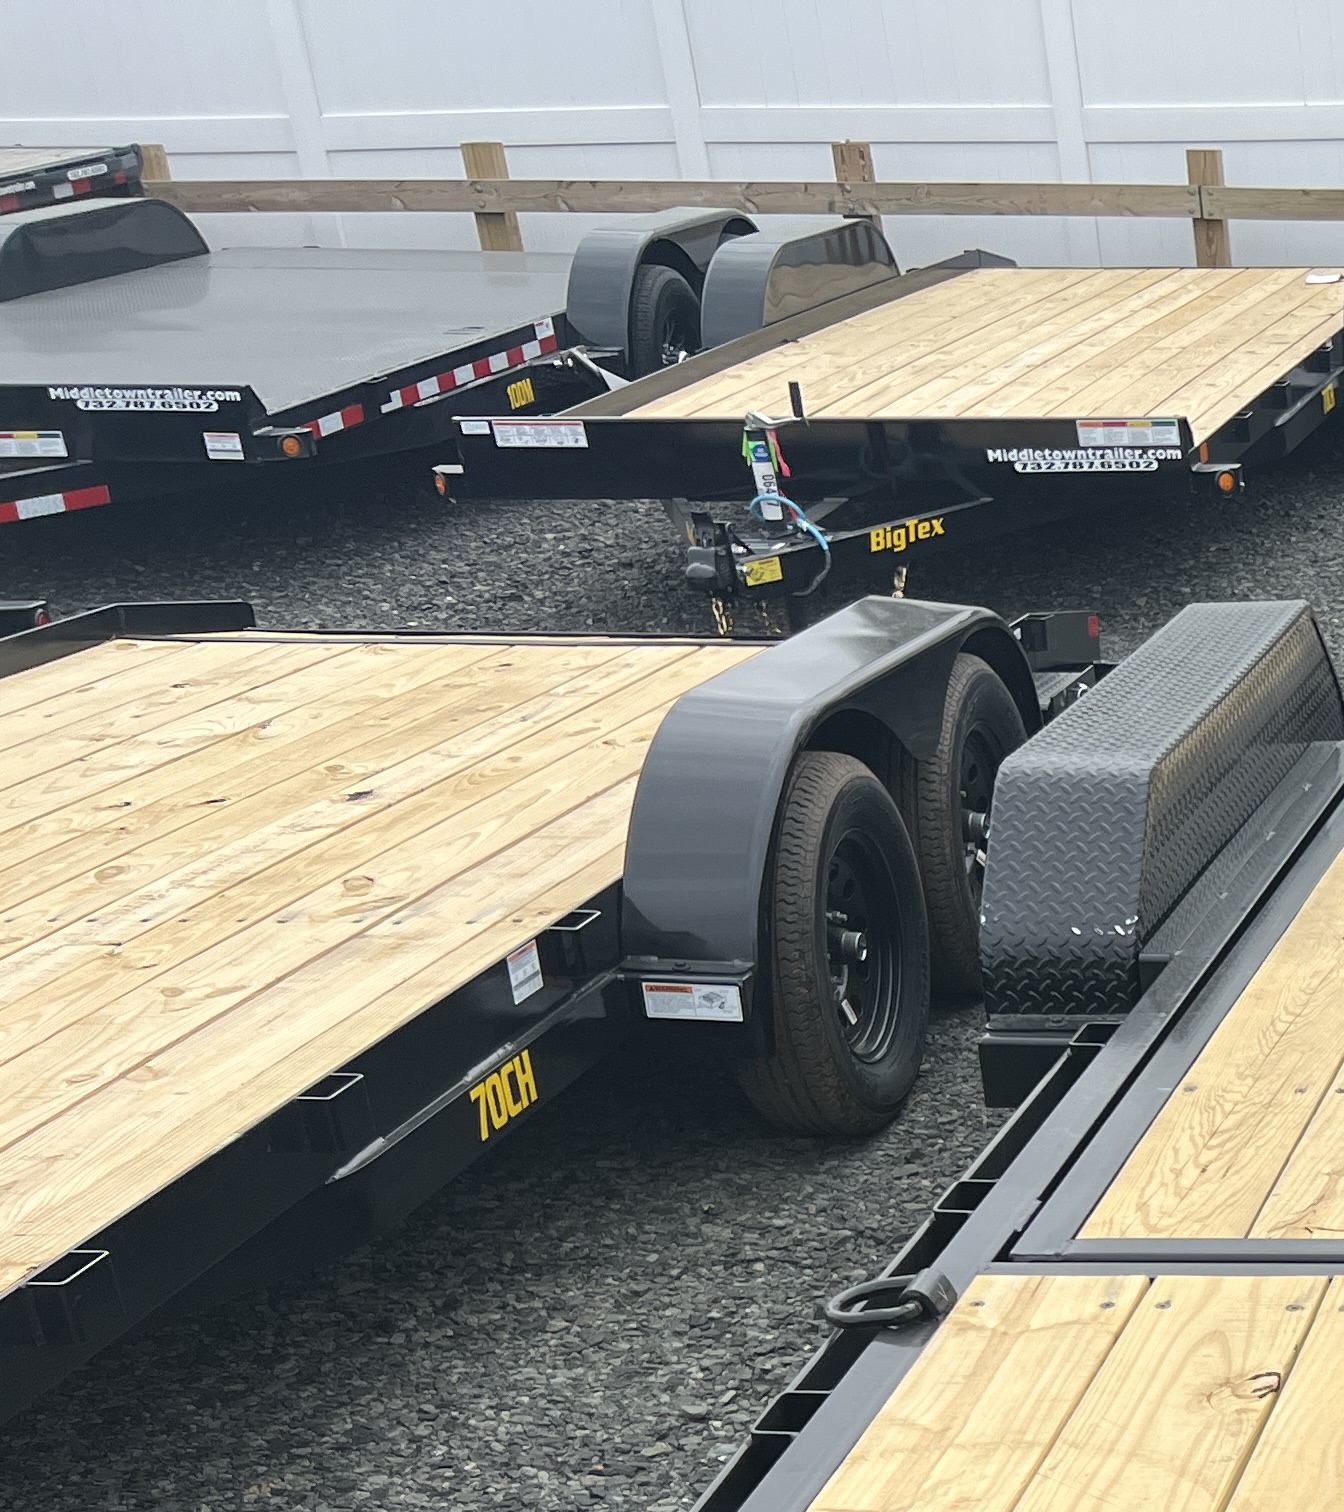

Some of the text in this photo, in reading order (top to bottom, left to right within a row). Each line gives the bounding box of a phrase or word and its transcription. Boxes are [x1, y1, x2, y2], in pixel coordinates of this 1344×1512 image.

[49, 387, 241, 402] Middletowntrailer.com
[986, 448, 1182, 462] Middletowntrailer.com
[1017, 461, 1156, 471] 732.787.6502
[869, 516, 945, 552] BigTex
[470, 1049, 539, 1142] 70CH
